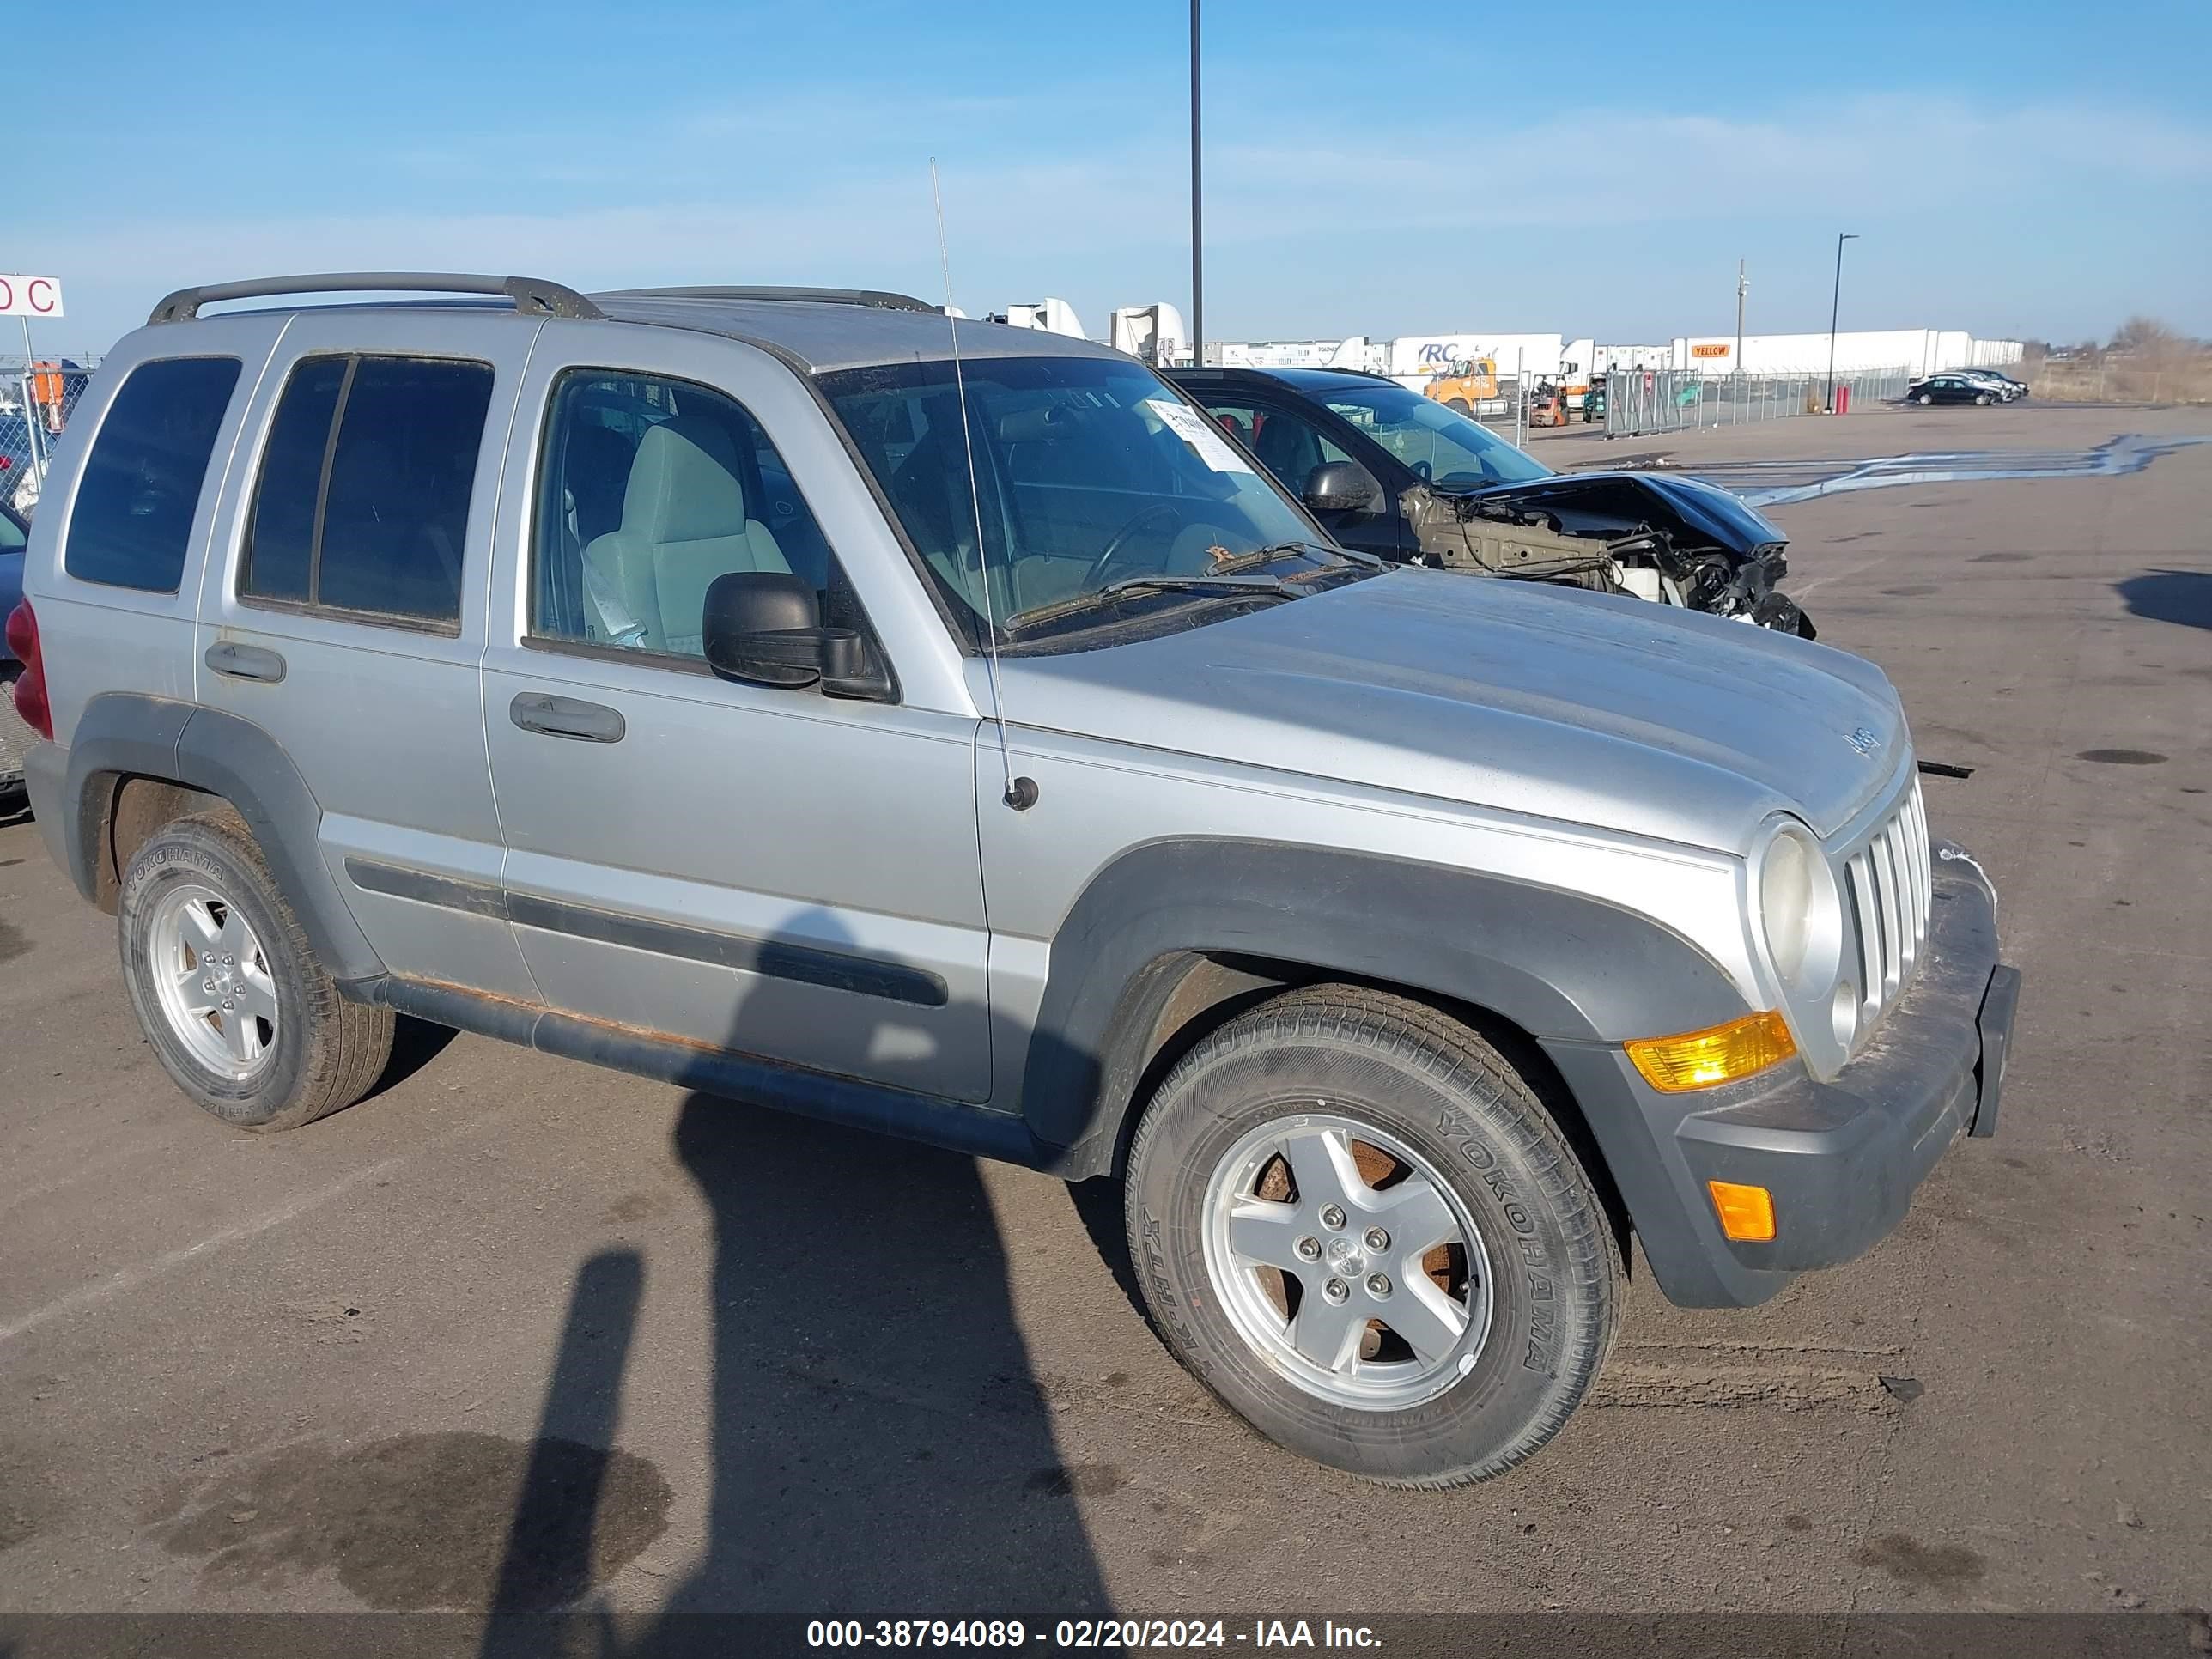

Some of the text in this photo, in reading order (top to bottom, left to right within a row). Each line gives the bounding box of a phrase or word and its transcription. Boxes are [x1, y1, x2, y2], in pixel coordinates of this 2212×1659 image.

[1418, 343, 1458, 362] YRC
[1696, 347, 1726, 356] YELLOW
[127, 845, 226, 892] YOKOHAMA
[1435, 1109, 1557, 1371] YOKOHAMA
